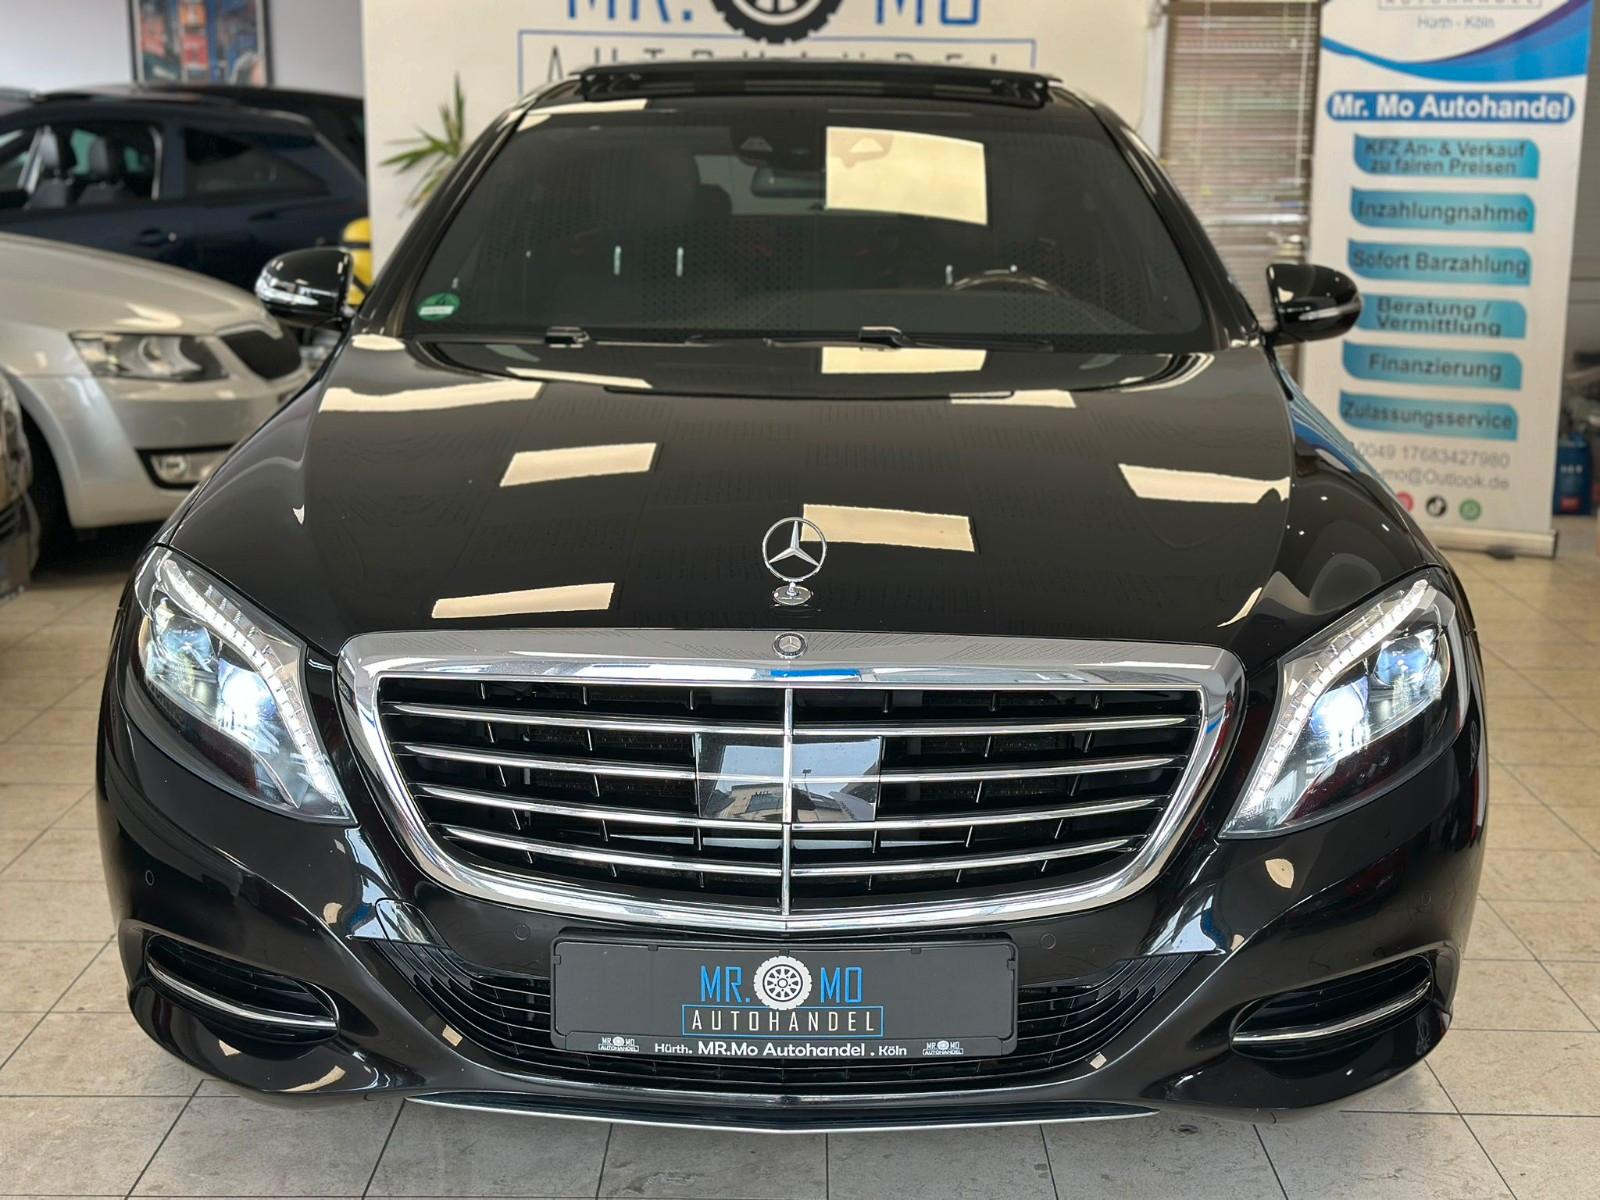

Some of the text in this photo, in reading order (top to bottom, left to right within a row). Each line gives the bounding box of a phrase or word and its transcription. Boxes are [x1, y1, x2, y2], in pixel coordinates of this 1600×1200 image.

[1332, 95, 1570, 120] Mr. Mo Autohandel
[1365, 140, 1526, 158] KFZ An- & Verkauf
[1371, 158, 1517, 175] zu fairen Preisen
[1357, 200, 1529, 225] Inzahlungnahme
[1352, 249, 1529, 279] Sofort Barzahlung
[1376, 297, 1492, 320] Beratung /
[1376, 314, 1503, 337] Vermittlung
[1368, 352, 1503, 383] Finanzierung
[1342, 399, 1513, 430] Zulassungsservice
[700, 965, 863, 1004] MR. MO
[691, 1009, 876, 1032] AUTOHANDEL
[654, 1042, 693, 1054] Hürth.
[698, 1040, 759, 1056] MR.Mo
[763, 1042, 866, 1057] Autohandel
[878, 1045, 907, 1056] Köln
